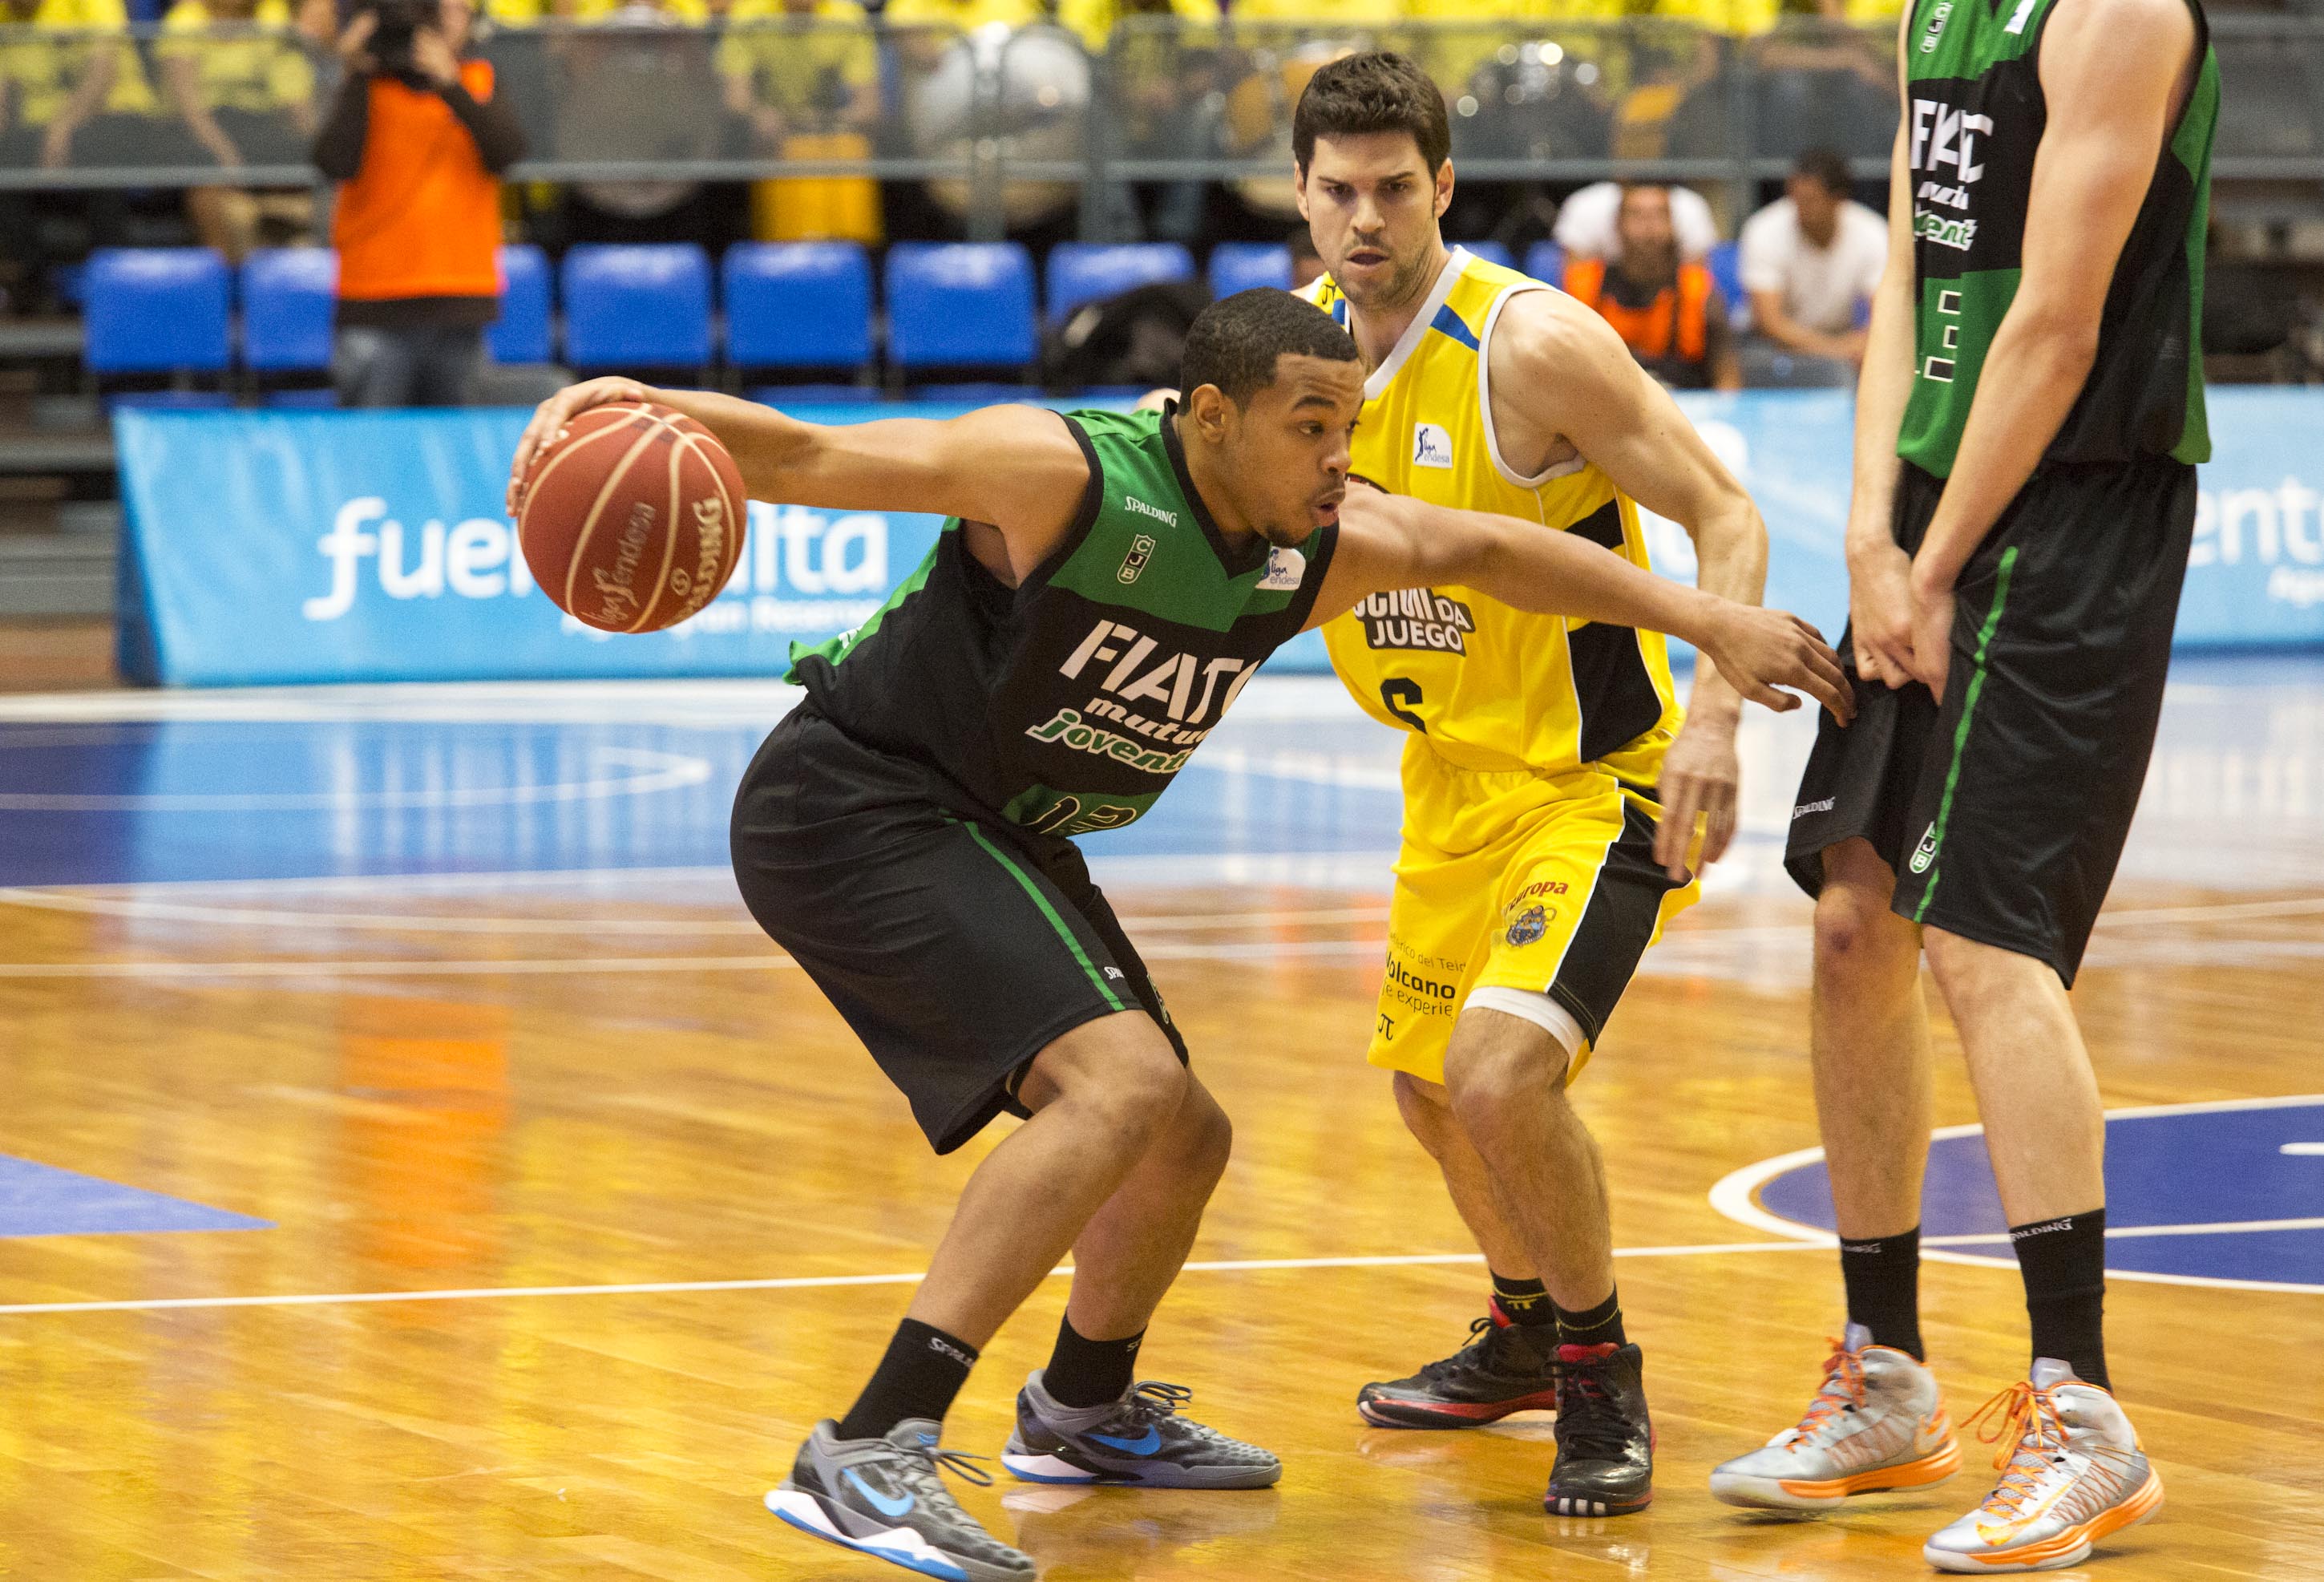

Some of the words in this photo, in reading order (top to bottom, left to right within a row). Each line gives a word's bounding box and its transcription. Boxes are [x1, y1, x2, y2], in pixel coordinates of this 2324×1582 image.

[1125, 496, 1178, 528] SPALDING
[1435, 598, 1472, 630] DA
[1372, 619, 1463, 652] JUEGO
[1025, 707, 1197, 774] jovent
